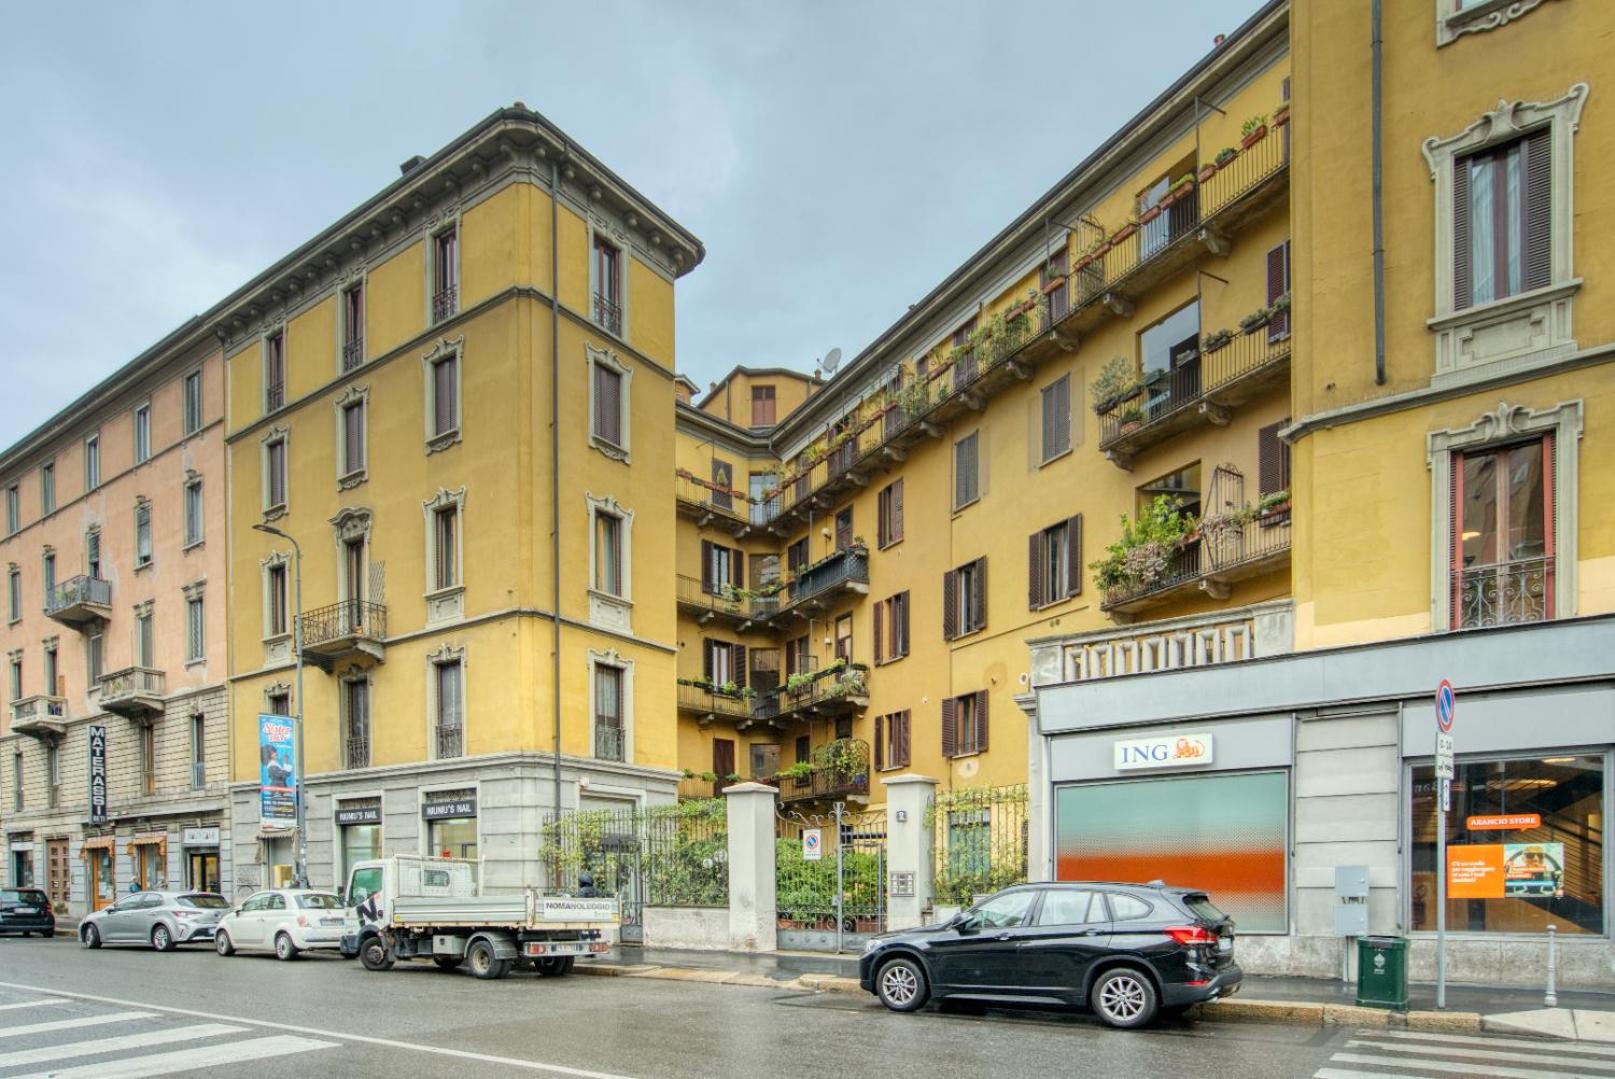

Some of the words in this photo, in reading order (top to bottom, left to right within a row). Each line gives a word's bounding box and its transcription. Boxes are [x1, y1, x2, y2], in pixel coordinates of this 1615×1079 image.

[1122, 743, 1168, 763] ING
[91, 727, 105, 815] MATERASSI
[457, 802, 472, 813] NAIL
[1471, 817, 1508, 826] ARANCIO
[1509, 816, 1537, 825] STORE
